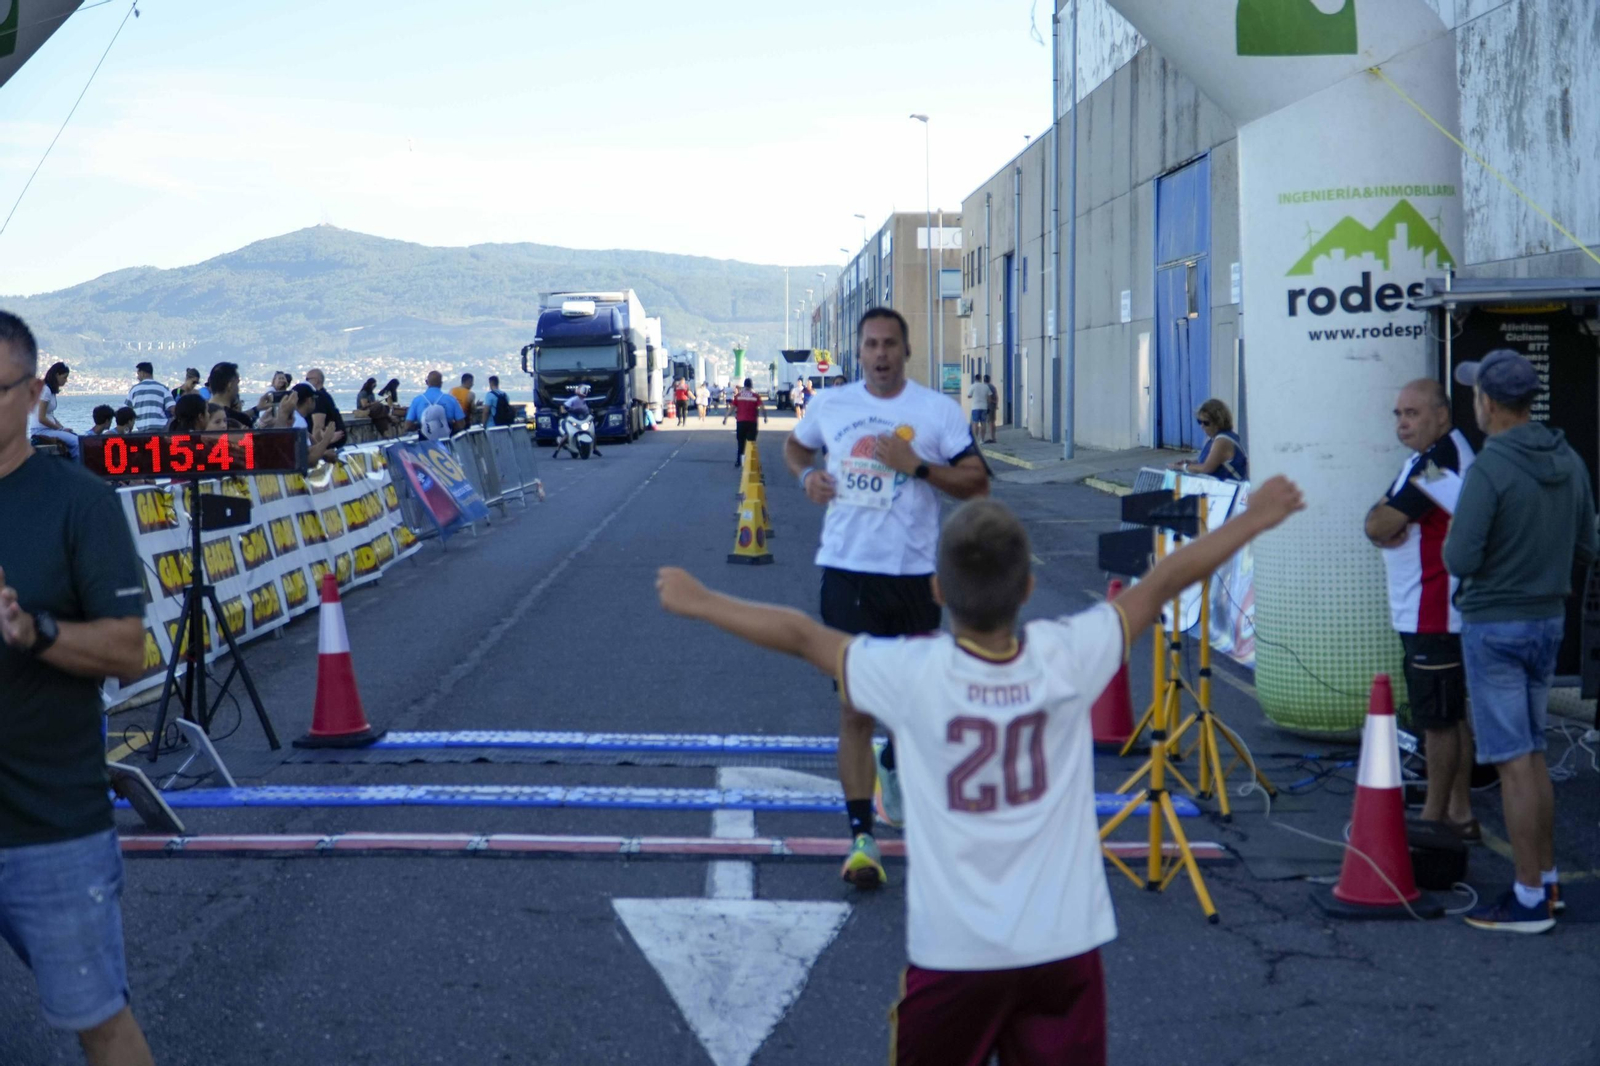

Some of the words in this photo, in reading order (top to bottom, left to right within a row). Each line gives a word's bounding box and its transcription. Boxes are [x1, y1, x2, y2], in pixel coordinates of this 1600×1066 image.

[1287, 271, 1425, 317] rodes
[1308, 321, 1427, 341] www.rodespi
[104, 432, 255, 474] 0:15:41
[846, 473, 883, 493] 560
[947, 711, 1046, 812] 20
